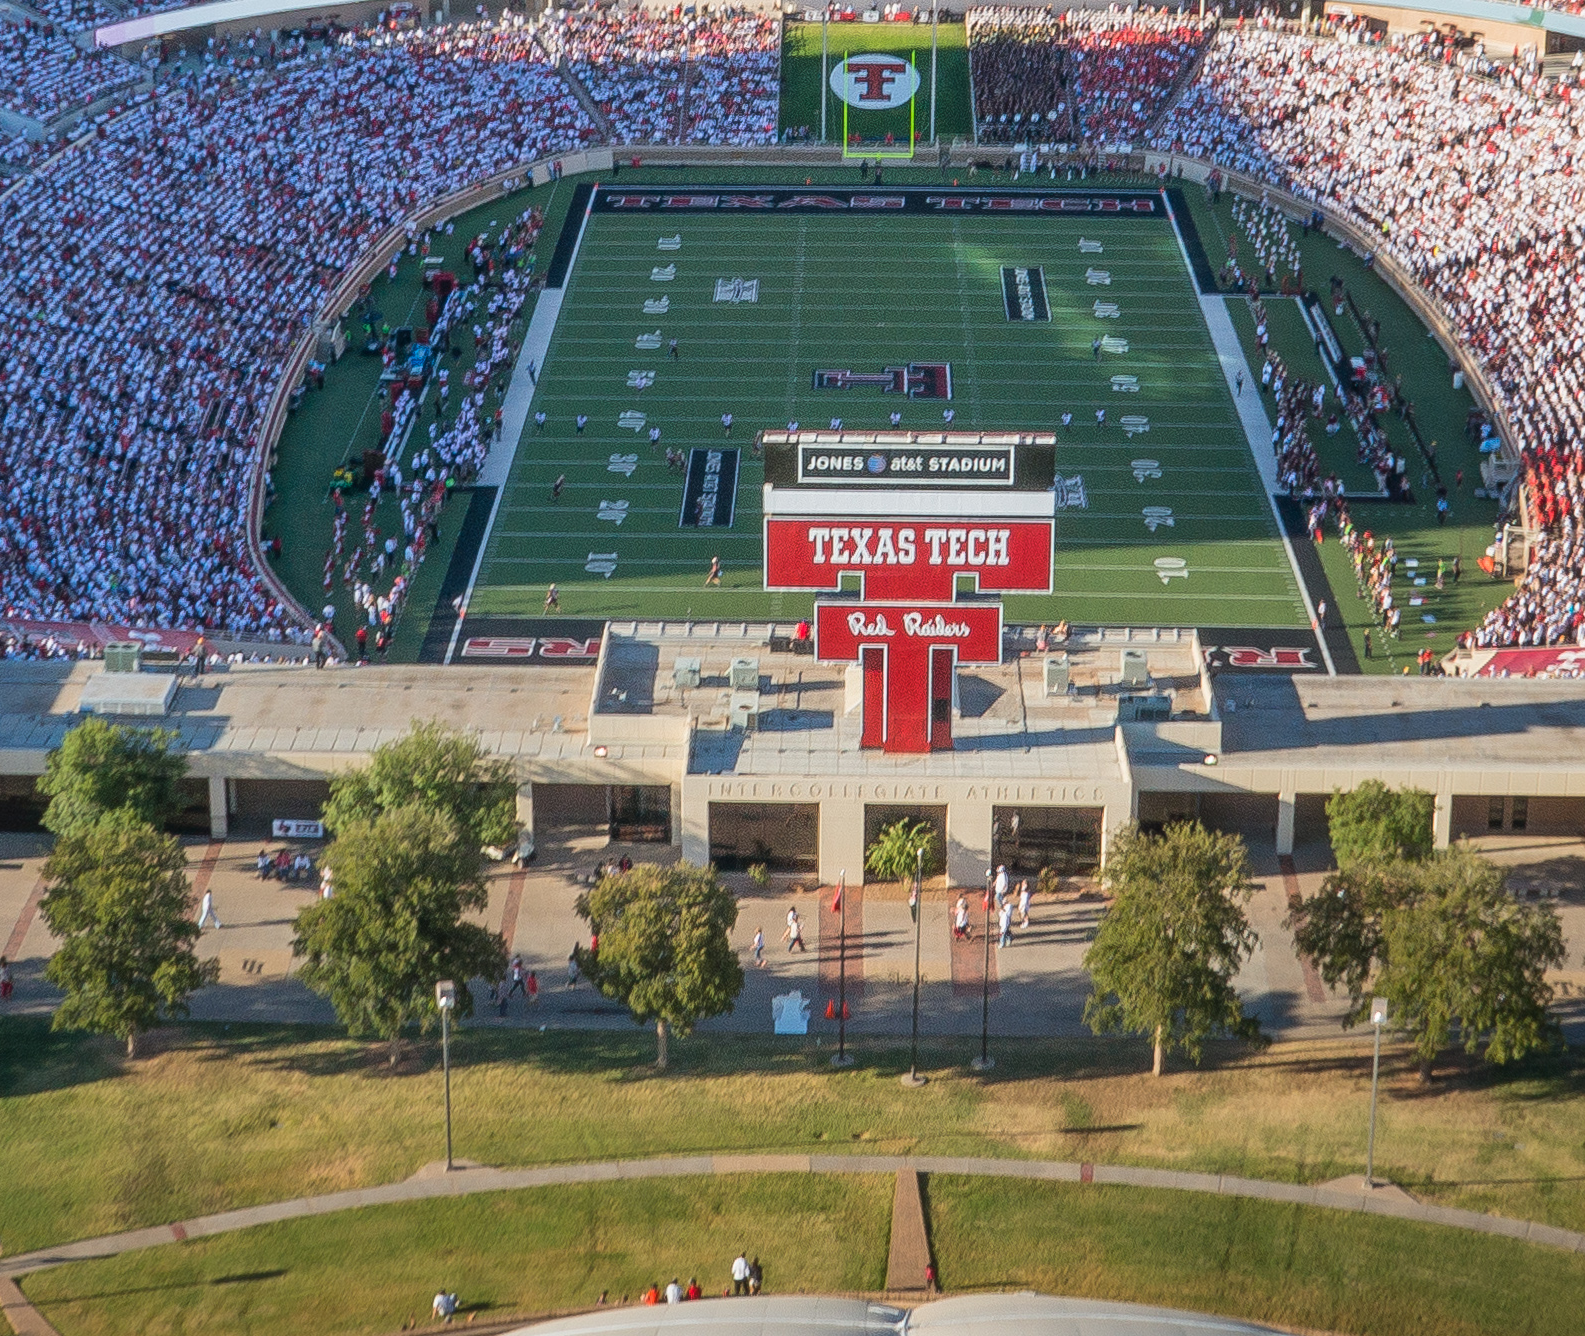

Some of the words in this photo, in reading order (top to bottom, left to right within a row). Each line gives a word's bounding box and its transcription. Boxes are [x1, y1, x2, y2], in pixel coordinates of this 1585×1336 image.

[807, 454, 864, 472] JONES
[890, 454, 923, 472] at&t
[928, 455, 1007, 473] STADIUM
[808, 526, 917, 565] TEXAS
[924, 527, 1011, 566] TECH
[846, 611, 897, 638] Red
[903, 612, 972, 639] Raiders
[708, 781, 946, 800] INTERCOLLEGIATE
[965, 784, 1105, 802] ATHLETICS
